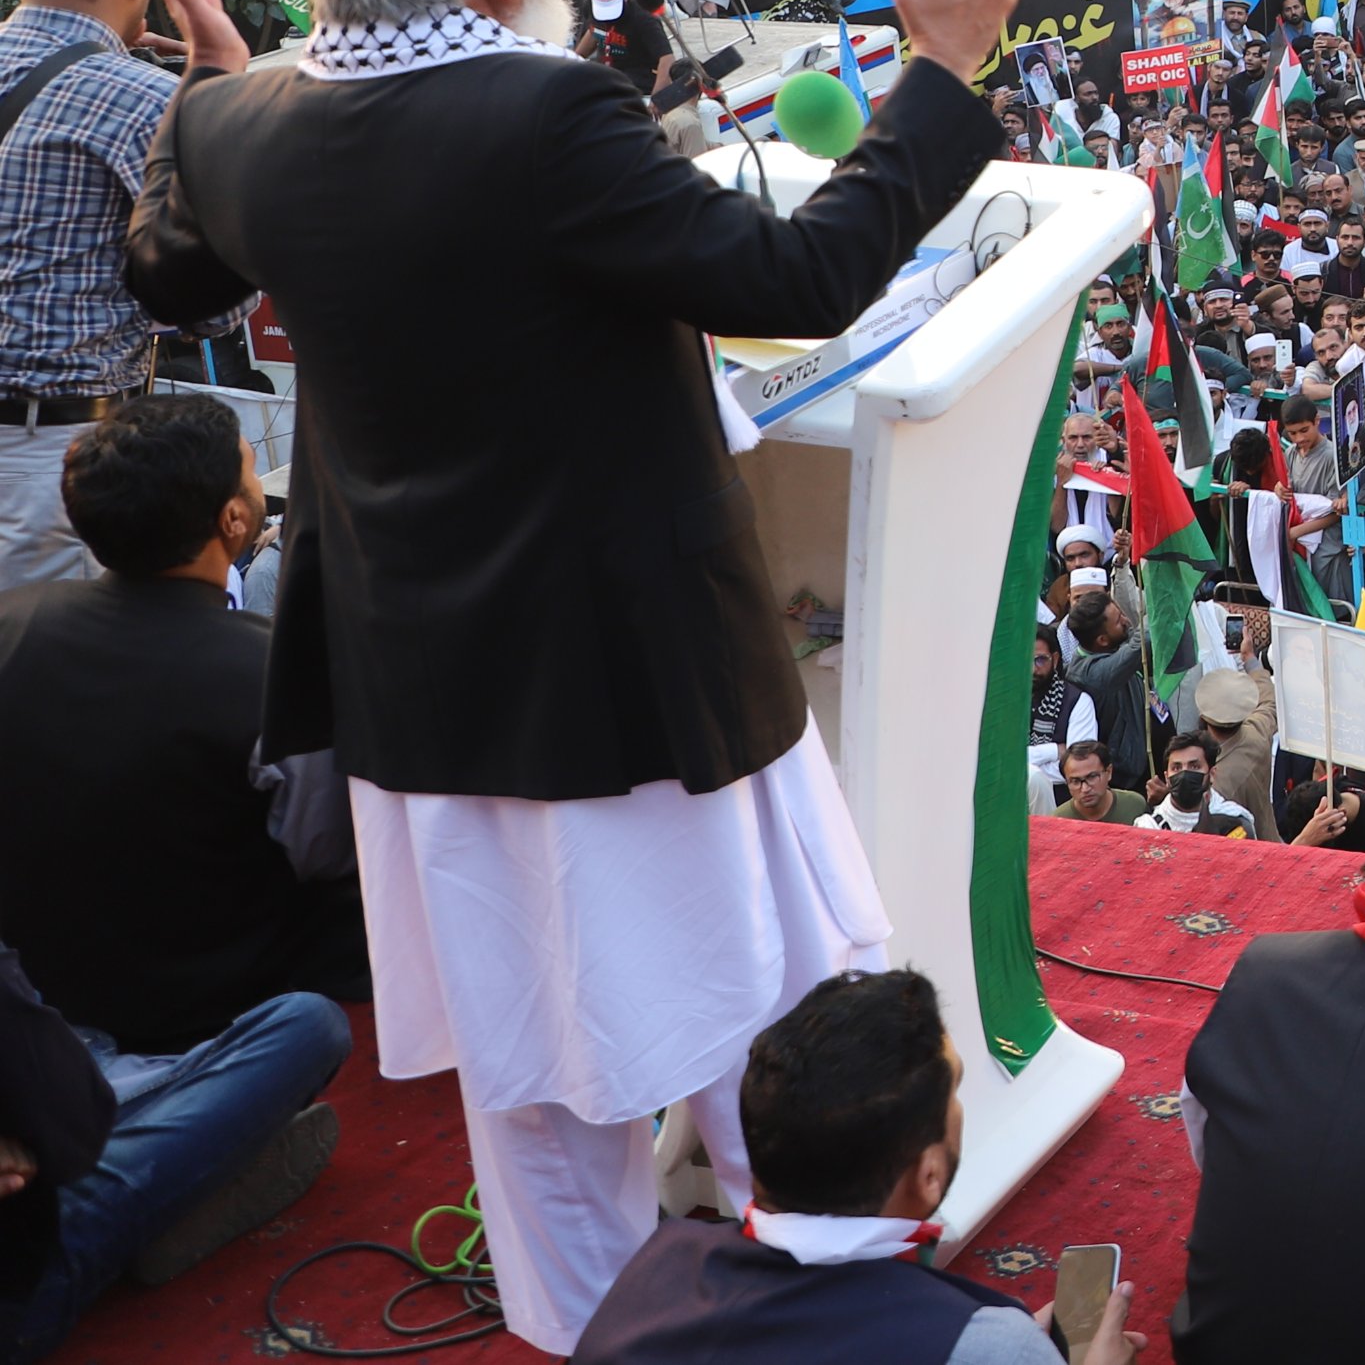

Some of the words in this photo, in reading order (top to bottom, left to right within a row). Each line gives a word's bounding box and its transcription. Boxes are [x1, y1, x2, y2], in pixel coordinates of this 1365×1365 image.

[1127, 52, 1184, 71] SHAME
[1127, 73, 1157, 87] FOR
[1160, 67, 1186, 81] OIC
[855, 308, 898, 337] PROFESSIONAL
[900, 294, 926, 313] MEETING
[873, 312, 911, 338] MICROPHONE
[262, 325, 287, 337] JAM
[784, 354, 822, 390] HTDZ
